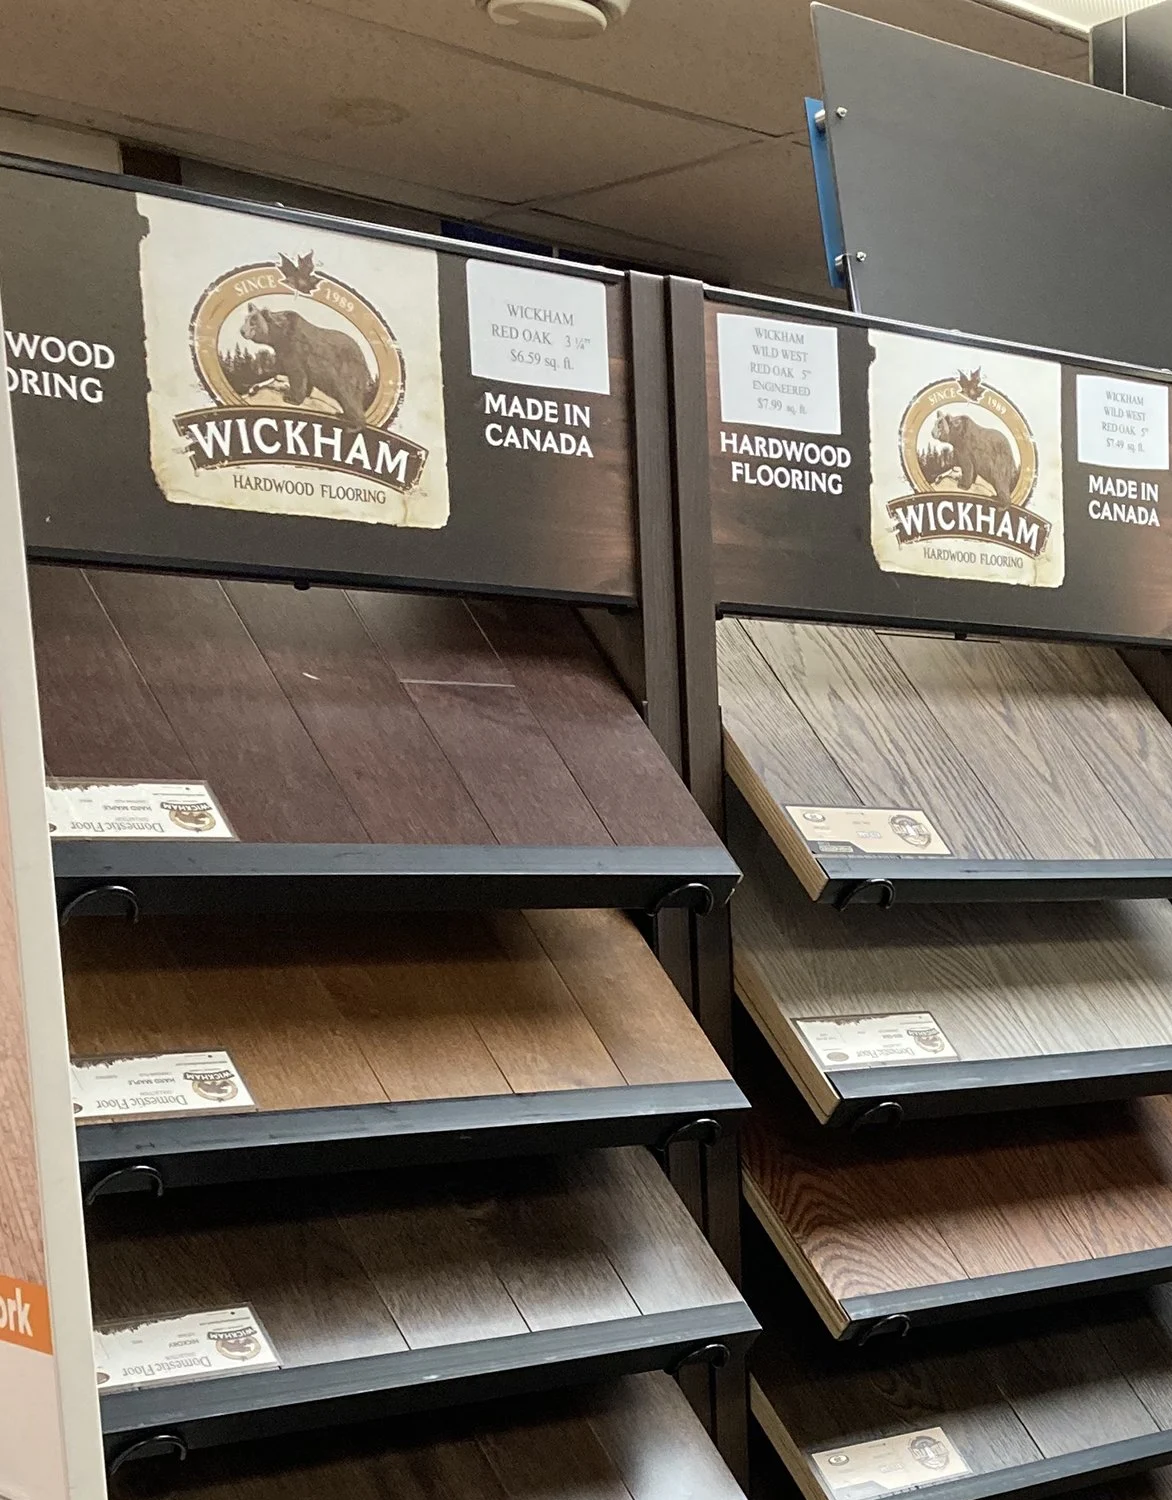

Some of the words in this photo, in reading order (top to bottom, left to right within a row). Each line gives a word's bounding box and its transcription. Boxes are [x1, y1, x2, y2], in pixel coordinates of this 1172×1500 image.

[233, 274, 277, 296] SINCE
[323, 286, 355, 314] 1989
[507, 304, 574, 326] WICKHAM
[491, 324, 518, 339] RED
[522, 329, 552, 345] OAK
[755, 328, 804, 345] WICKHAM
[752, 345, 778, 358] WILD
[782, 349, 808, 362] WEST
[750, 362, 770, 374] RED
[772, 365, 794, 378] OAK
[752, 380, 811, 396] ENGINEERED
[928, 389, 957, 405] SINCE
[1105, 391, 1143, 406] WICKHAM
[485, 392, 559, 424] MADE
[564, 403, 591, 428] IN
[1102, 421, 1117, 433] RED
[484, 424, 593, 458] CANADA
[188, 416, 410, 484] WICKHAM
[720, 431, 851, 469] HARDWOOD
[731, 461, 843, 495] FLOORING
[233, 474, 314, 496] HARDWOOD
[321, 484, 386, 505] FLOORING
[1089, 475, 1137, 500] MADE
[1141, 484, 1159, 502] IN
[1088, 500, 1161, 527] CANADA
[896, 501, 1040, 549] WICKHAM
[923, 547, 977, 564] HARDWOOD
[980, 553, 1023, 568] FLOORING
[161, 802, 213, 812] WICKHAM
[70, 821, 104, 833] Floor
[105, 821, 164, 833] Domestic
[186, 1072, 232, 1081] WICKHAM
[96, 1100, 129, 1110] Floor
[130, 1094, 188, 1105] Domestic
[210, 1327, 254, 1340] WICKHAM
[122, 1364, 154, 1377] Floor
[156, 1356, 212, 1372] Domestic
